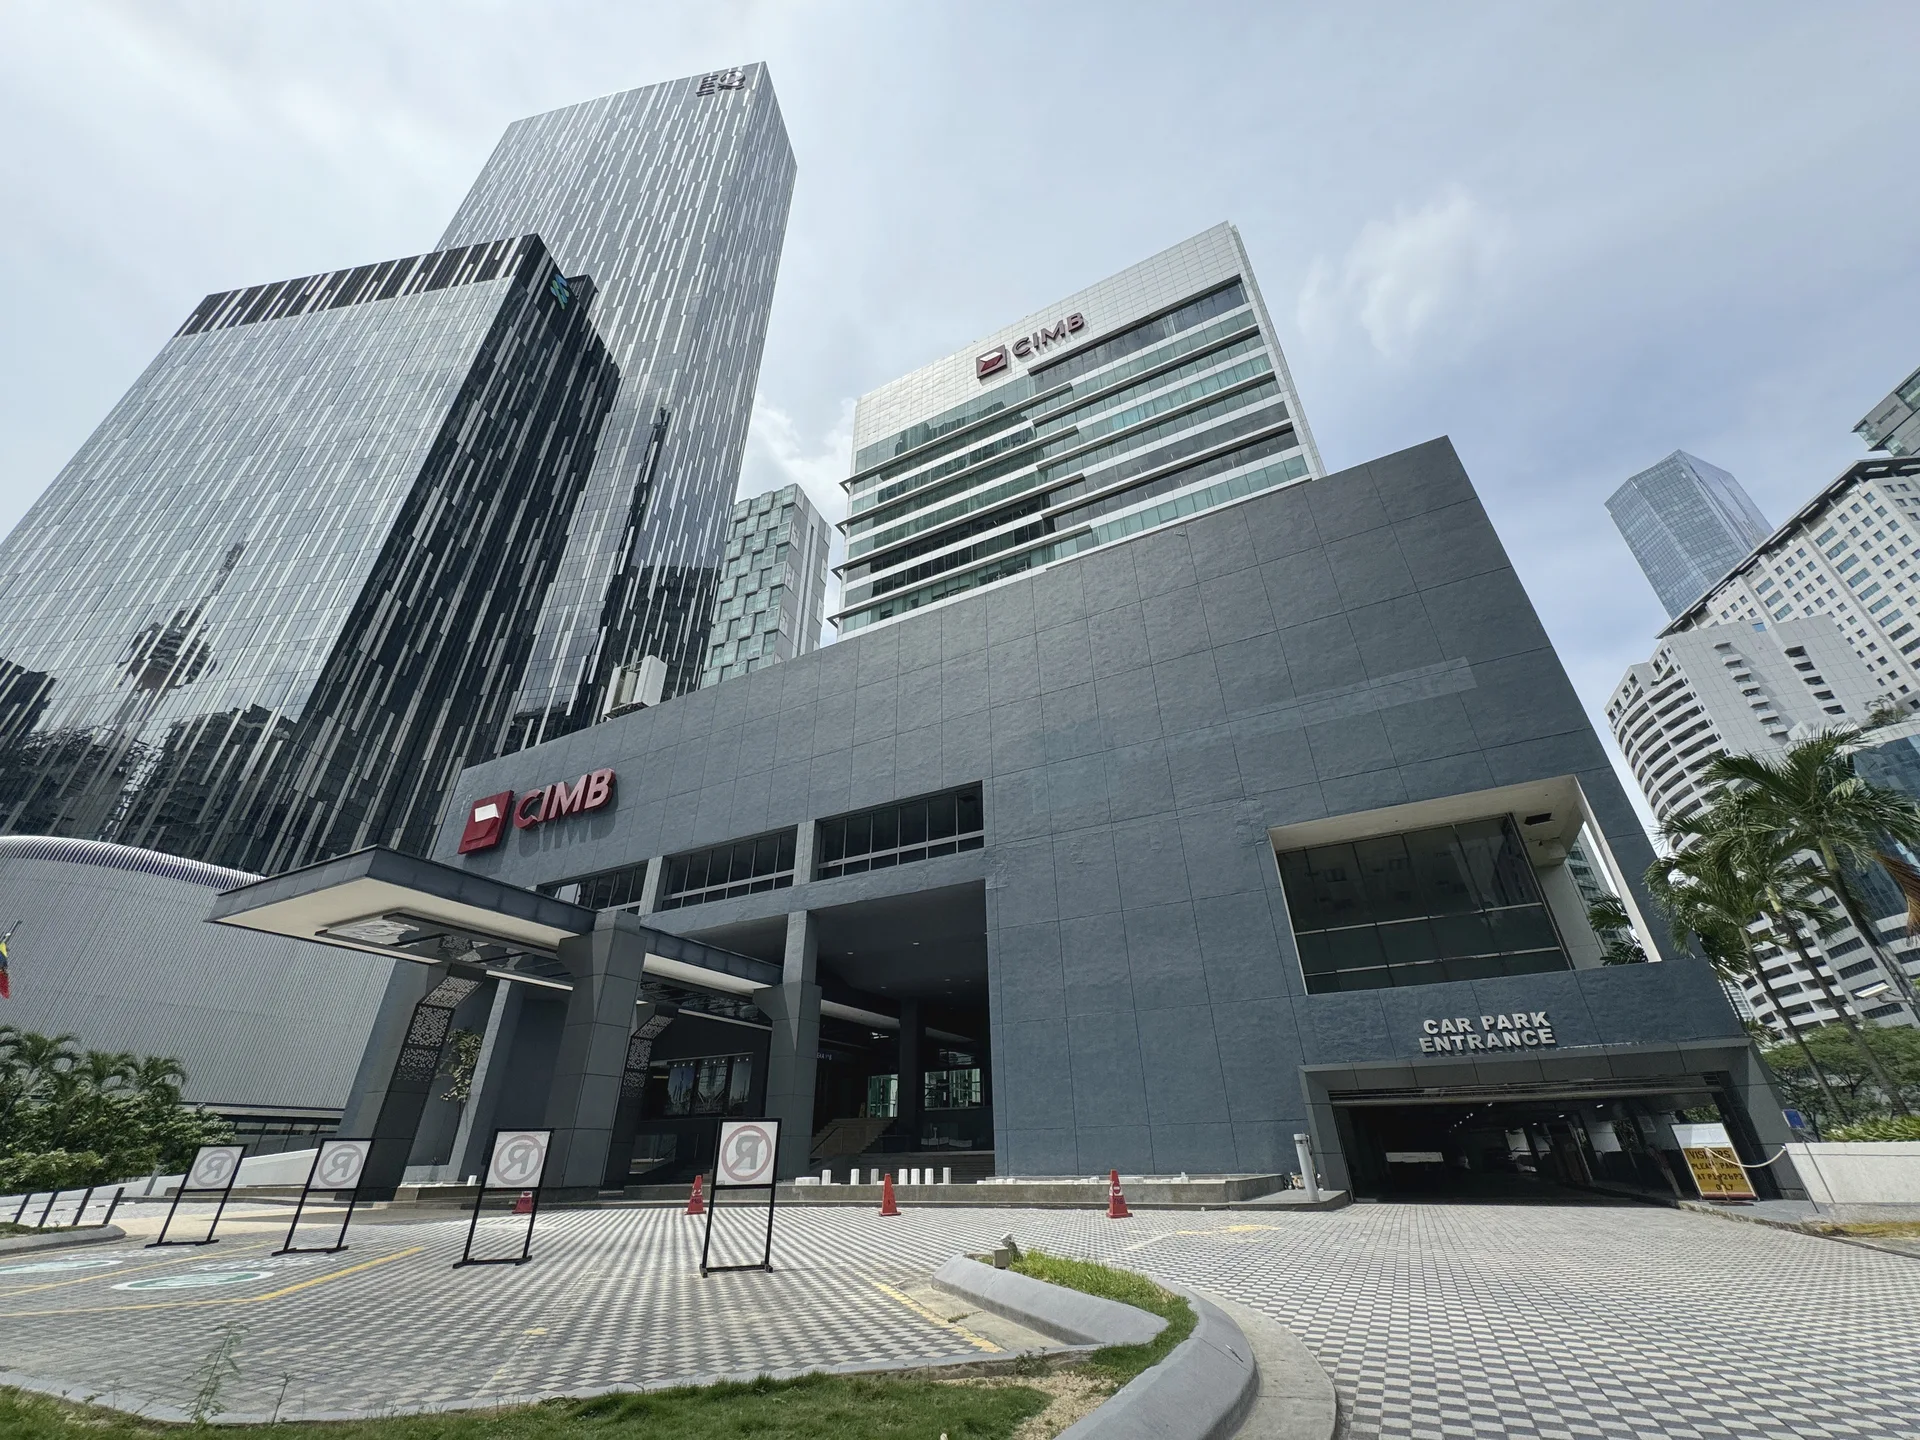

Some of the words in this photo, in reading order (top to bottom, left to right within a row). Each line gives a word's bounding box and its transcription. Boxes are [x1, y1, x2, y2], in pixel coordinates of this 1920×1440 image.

[696, 71, 746, 97] EQ
[1012, 312, 1085, 357] CIMB
[513, 768, 616, 829] CIMB
[1423, 1017, 1474, 1035] CAR
[1480, 1011, 1551, 1030] PARK
[1418, 1028, 1556, 1053] ENTRANCE
[1689, 1150, 1731, 1160] VISIORS
[1715, 1183, 1733, 1191] OLY
